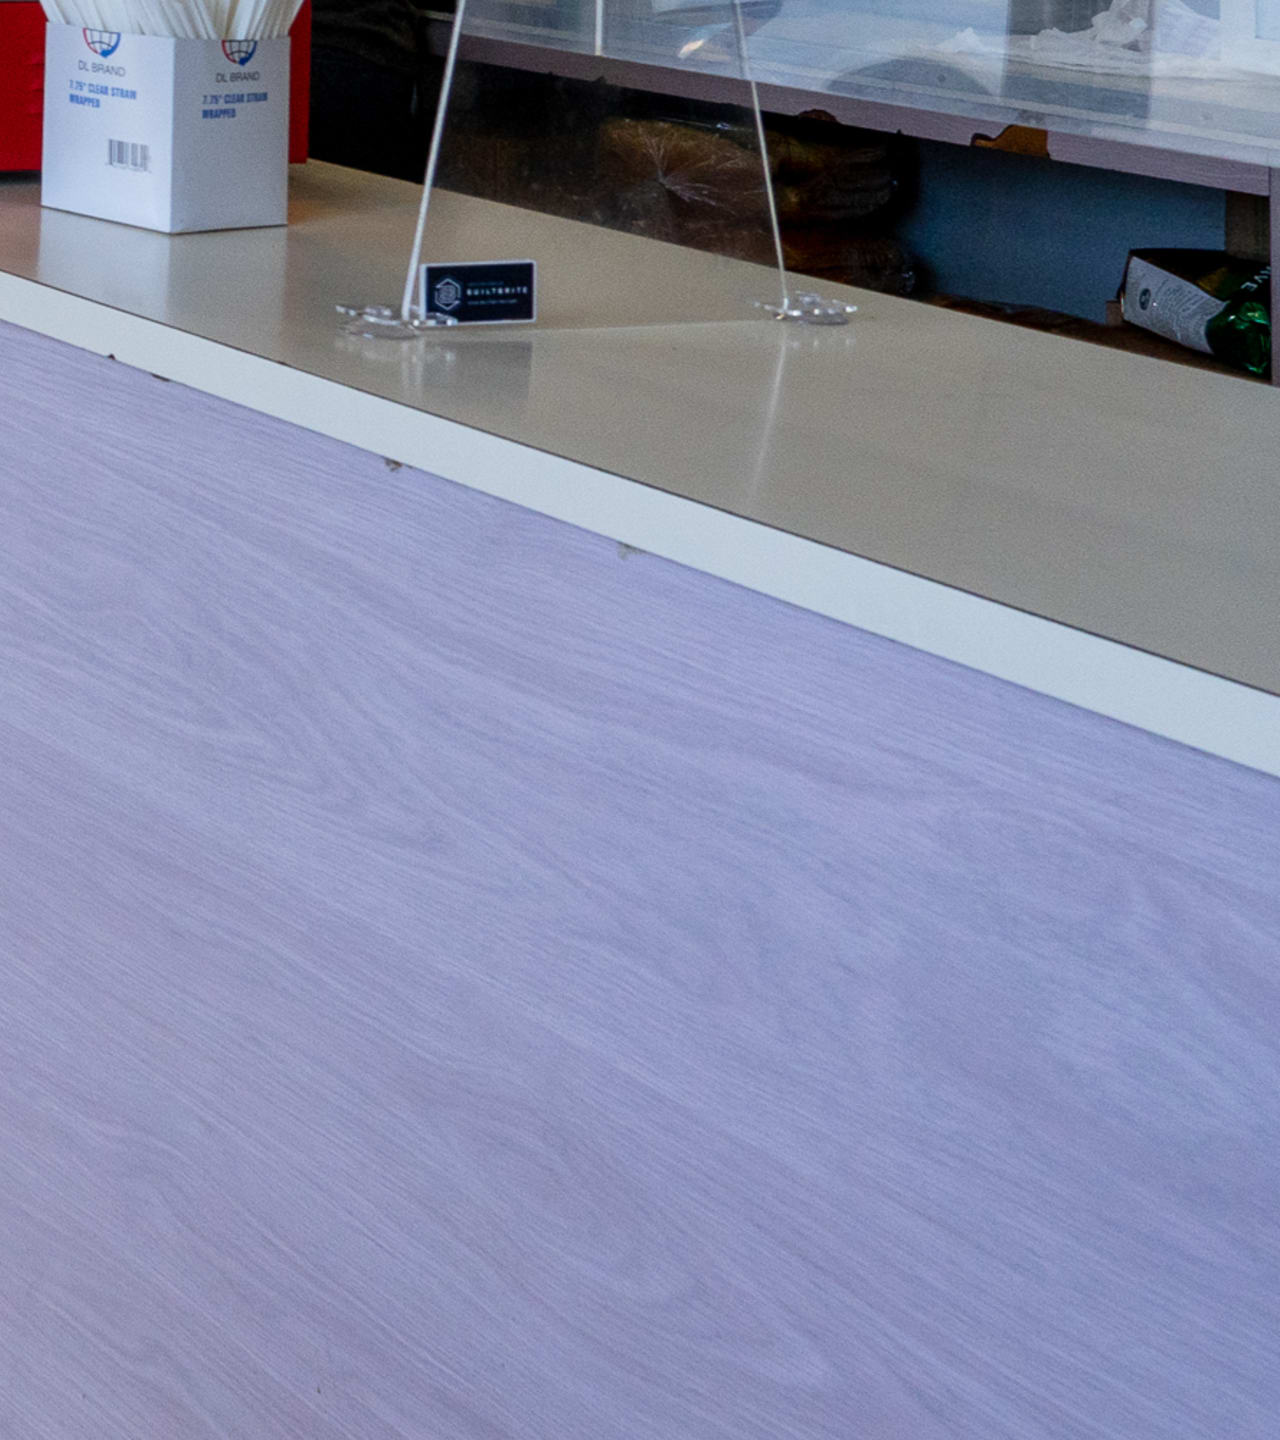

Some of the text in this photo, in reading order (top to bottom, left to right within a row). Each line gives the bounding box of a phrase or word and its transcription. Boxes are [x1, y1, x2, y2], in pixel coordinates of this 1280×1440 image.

[78, 59, 126, 77] DL BRAND
[215, 70, 260, 84] DL BRAND
[87, 83, 137, 100] CLEAR STRAW
[69, 93, 101, 108] WRAPPED
